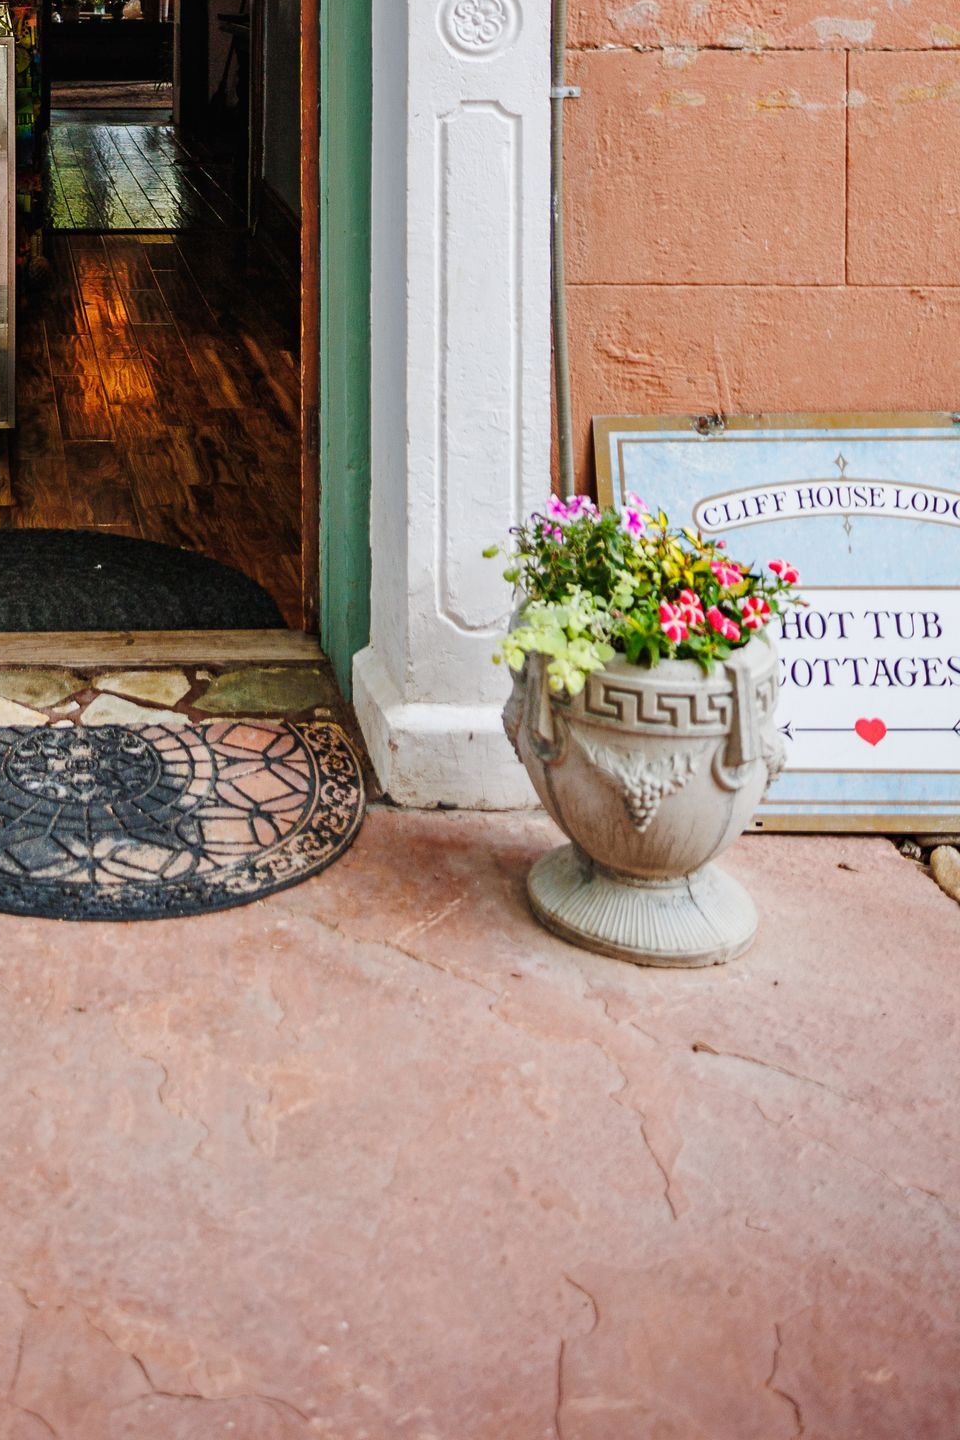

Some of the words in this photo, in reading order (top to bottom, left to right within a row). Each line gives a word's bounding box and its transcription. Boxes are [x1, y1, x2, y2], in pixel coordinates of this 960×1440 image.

[703, 491, 786, 526] CLIFF
[795, 486, 885, 510] HOUSE
[779, 610, 855, 640] HOT
[863, 610, 943, 640] TUB
